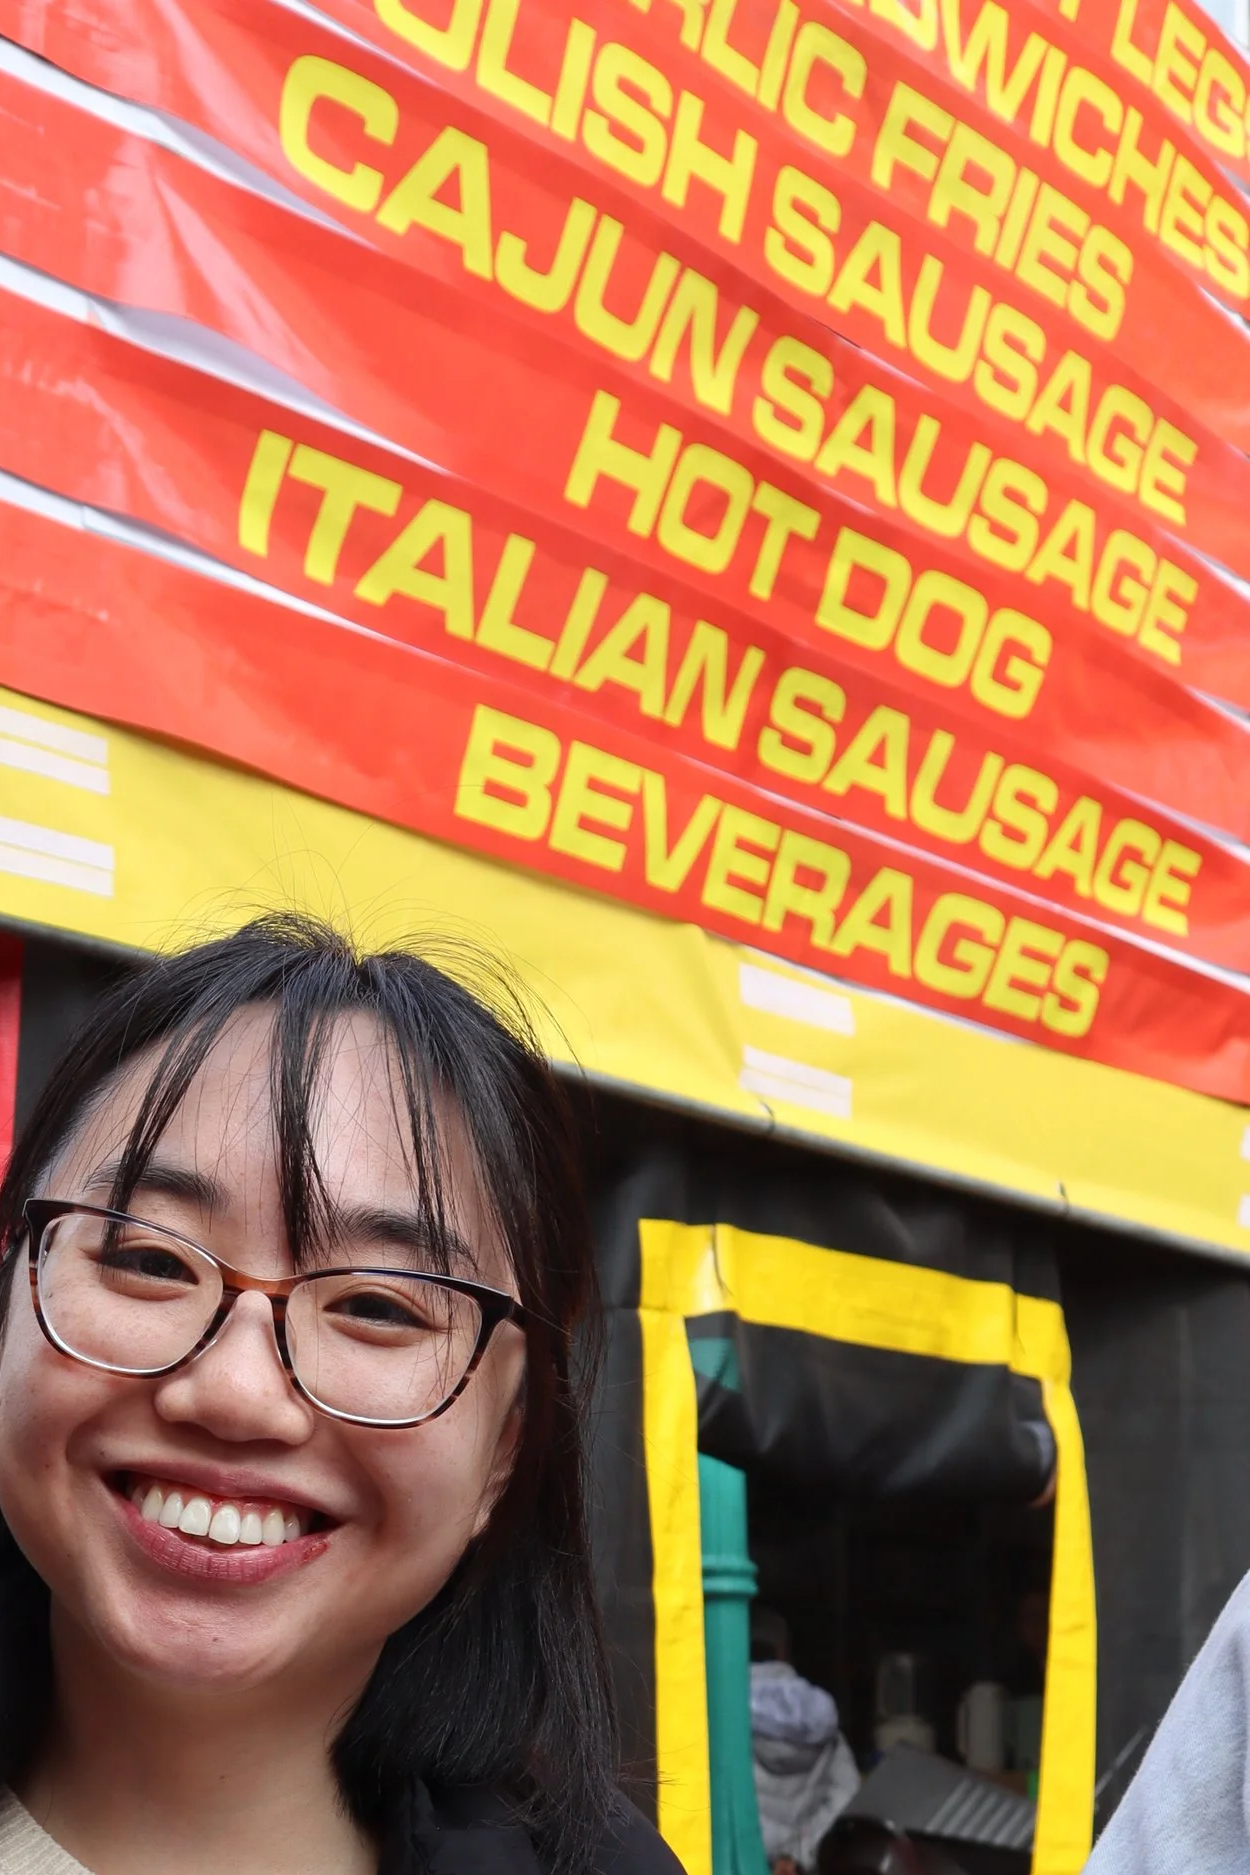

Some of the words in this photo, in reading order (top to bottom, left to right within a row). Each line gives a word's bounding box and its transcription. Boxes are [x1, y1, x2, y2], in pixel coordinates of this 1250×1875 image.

[871, 80, 1133, 342] FRIES
[1111, 0, 1250, 162] LEG
[279, 54, 759, 415] CAJUN
[753, 333, 1199, 666] SAUSAGE
[764, 165, 1199, 526] SAUSAGE
[238, 429, 764, 752] ITALIAN
[758, 666, 1202, 937] SAUSAGE
[564, 389, 820, 602] HOT
[814, 525, 1052, 719] DOG
[455, 702, 1109, 1038] BEVERAGES
